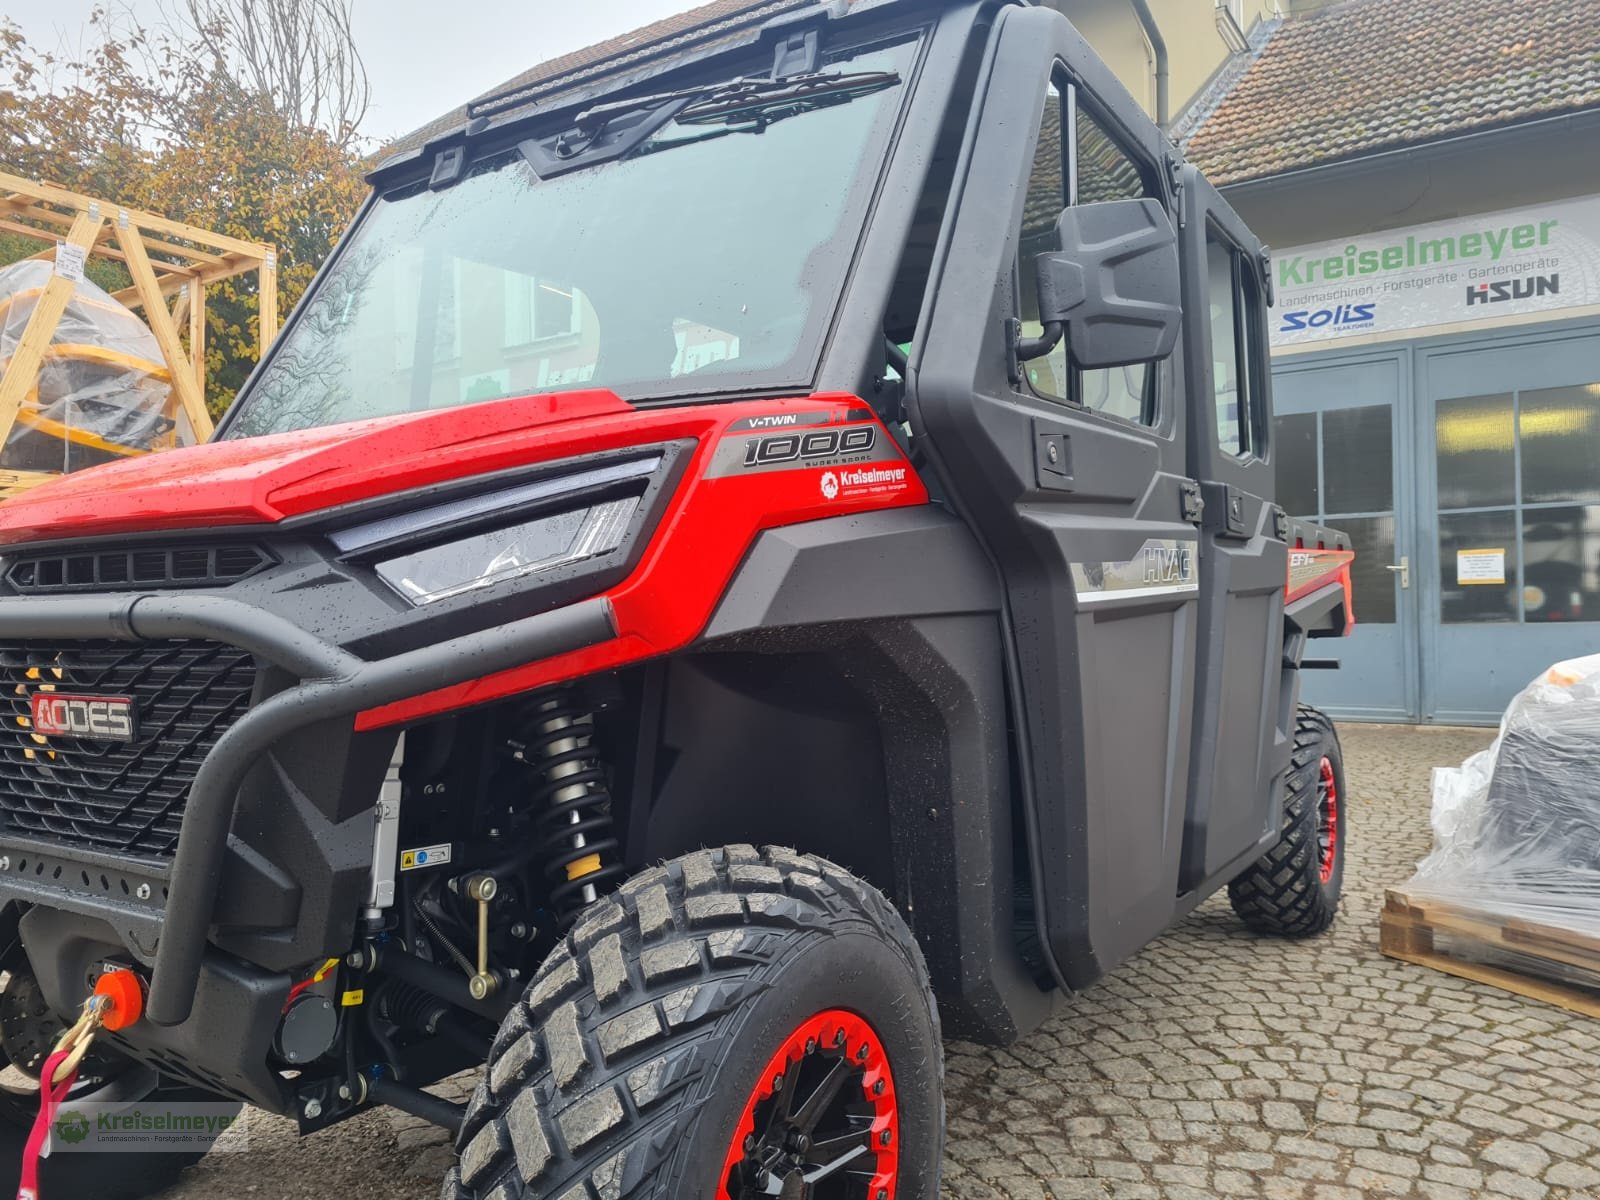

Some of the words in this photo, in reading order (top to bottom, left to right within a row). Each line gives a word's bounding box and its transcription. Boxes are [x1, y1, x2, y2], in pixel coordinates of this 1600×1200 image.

[1279, 219, 1559, 287] Kreiselmeyer
[1279, 285, 1374, 307] Landmaschinen
[1383, 270, 1458, 292] Forstgeräte
[1468, 256, 1559, 280] Gartengeräte
[748, 414, 797, 428] V-TWIN
[743, 426, 876, 467] 1000
[840, 467, 906, 486] Kreiselmeyer
[37, 699, 130, 735] AODES
